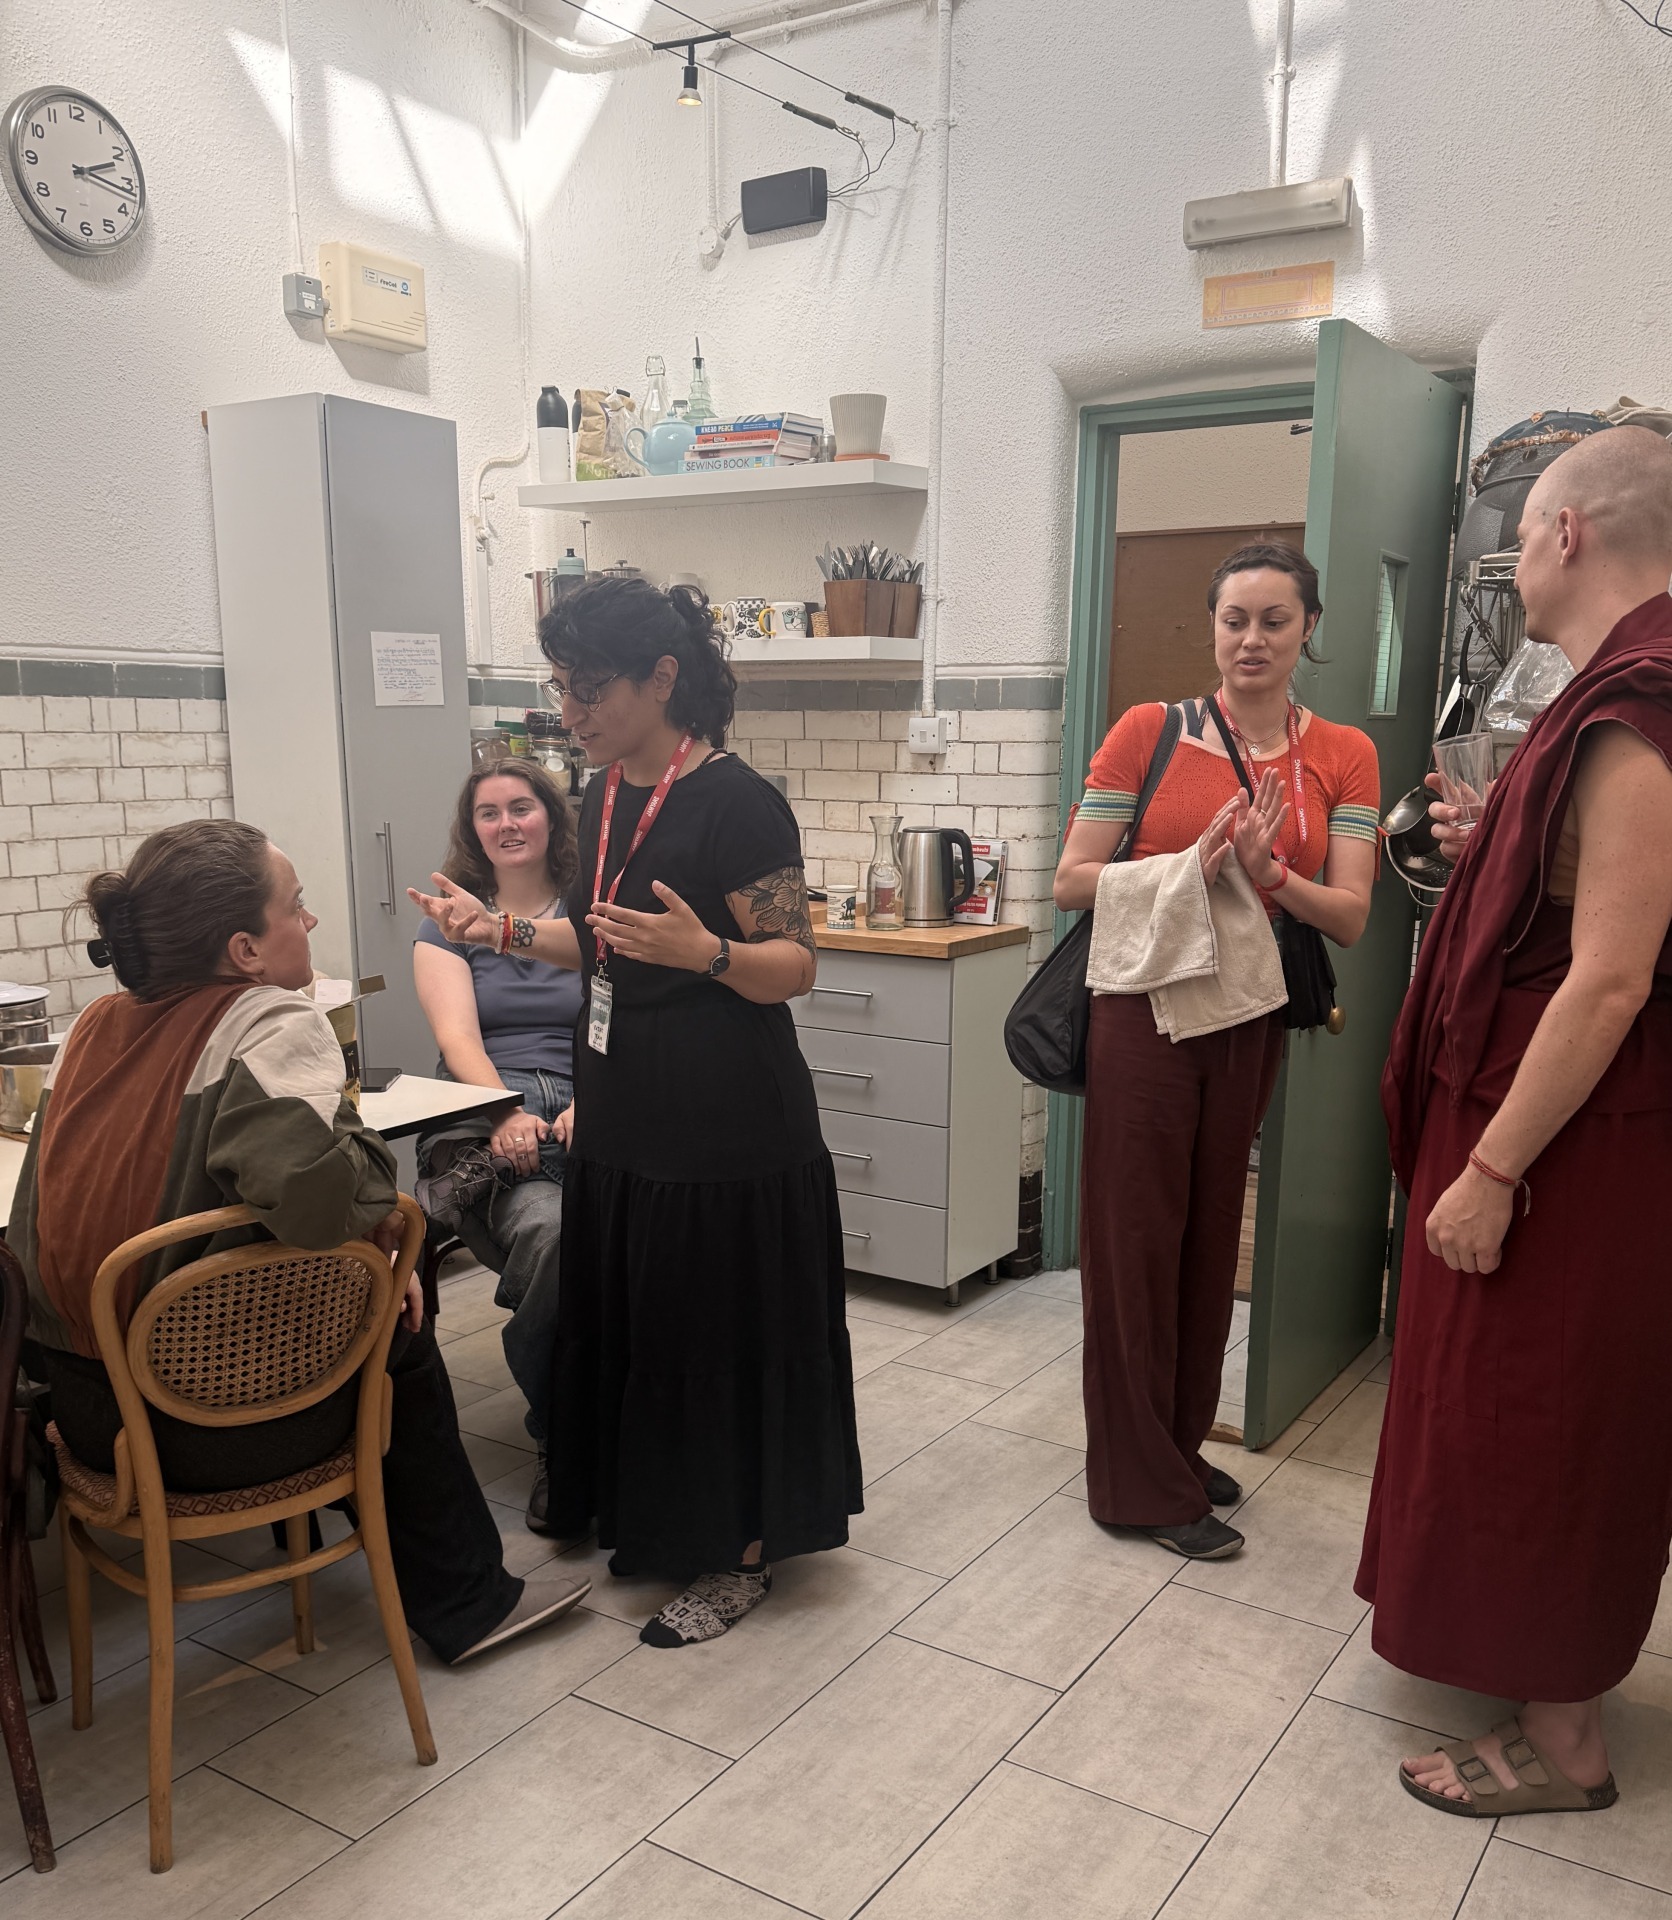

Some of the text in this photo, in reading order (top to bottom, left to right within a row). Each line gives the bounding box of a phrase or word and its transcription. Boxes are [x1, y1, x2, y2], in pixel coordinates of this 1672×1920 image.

[47, 107, 57, 123] 11
[69, 104, 85, 122] 12
[31, 122, 45, 139] 10
[25, 150, 38, 165] 9
[112, 146, 124, 161] 2
[36, 182, 50, 197] 8
[121, 176, 133, 192] 3
[56, 207, 67, 223] 7
[118, 203, 129, 217] 4
[80, 221, 93, 236] 6
[102, 218, 115, 234] 5
[686, 460, 721, 472] SEWING
[723, 458, 750, 470] BOOK
[1291, 716, 1299, 745] JAMYANG
[1294, 759, 1303, 793] JAMYANG
[1299, 807, 1307, 842] JAMYANG
